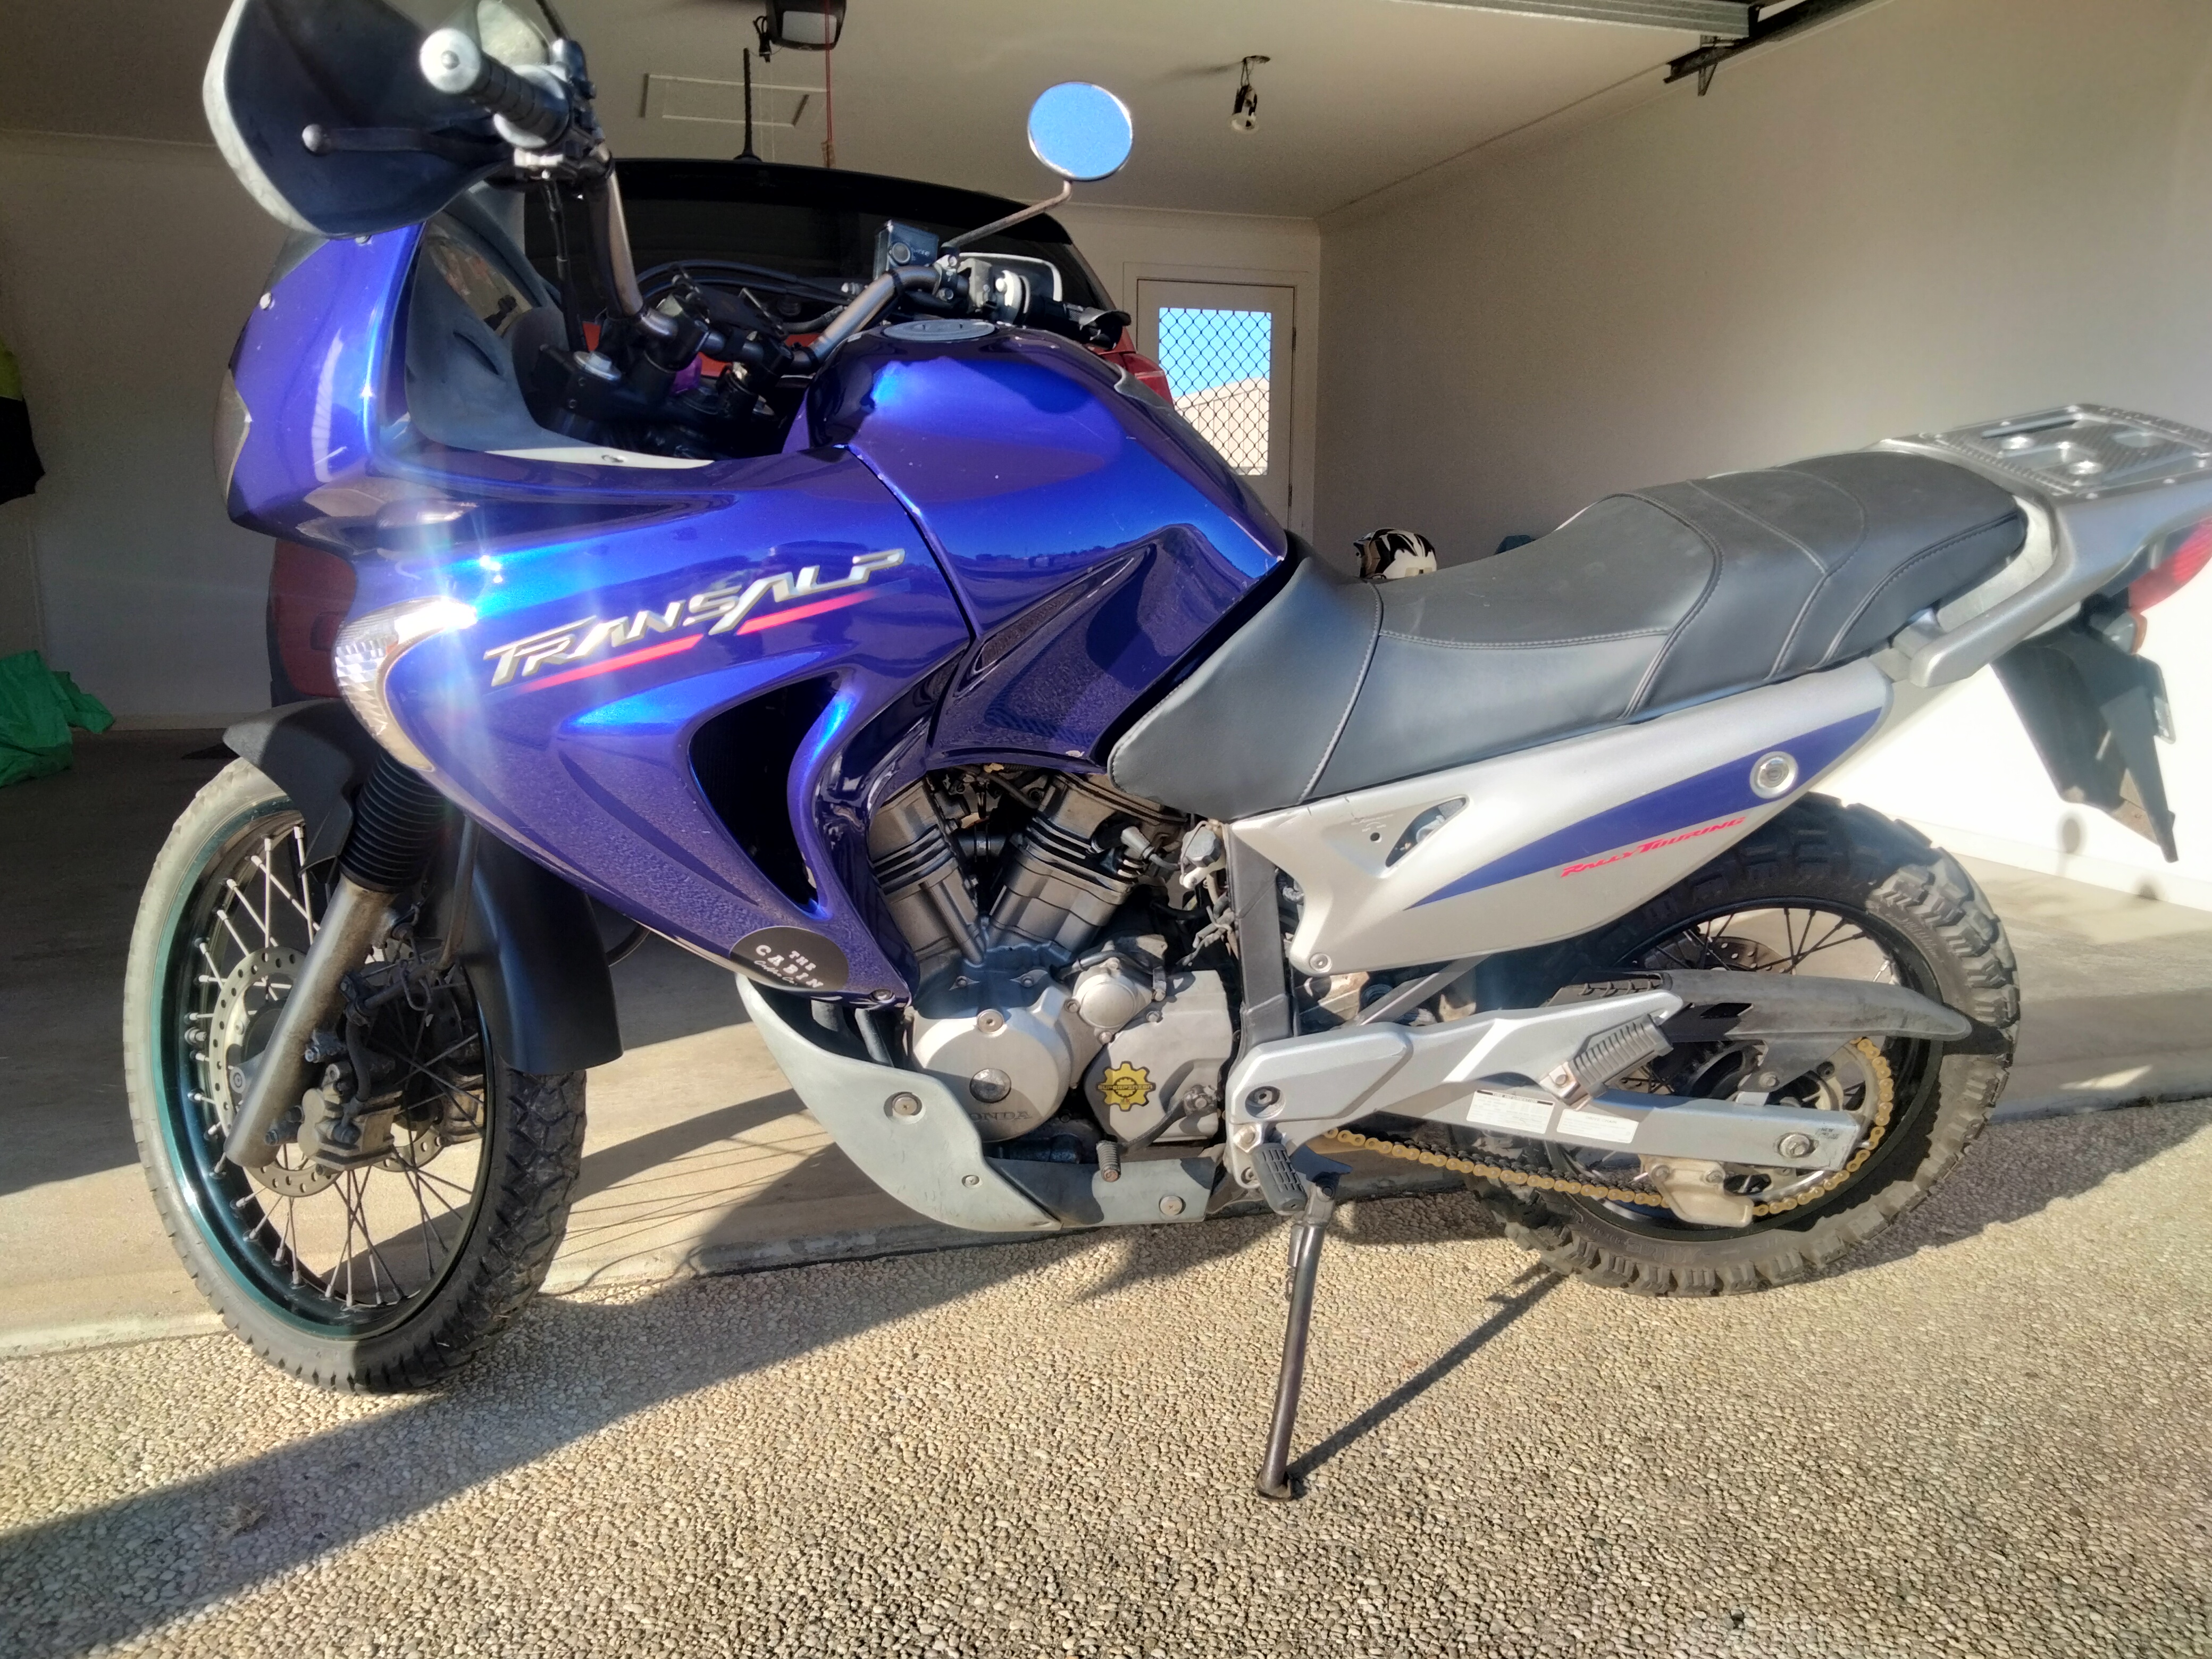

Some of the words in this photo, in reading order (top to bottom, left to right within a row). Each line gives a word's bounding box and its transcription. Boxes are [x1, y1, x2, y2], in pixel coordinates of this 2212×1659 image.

[483, 548, 906, 686] TRANSALP
[1560, 849, 1638, 877] RALLY
[1638, 816, 1746, 853] TOURING
[756, 944, 824, 988] CABIN
[789, 950, 817, 971] THE
[969, 1111, 1033, 1122] ONDA
